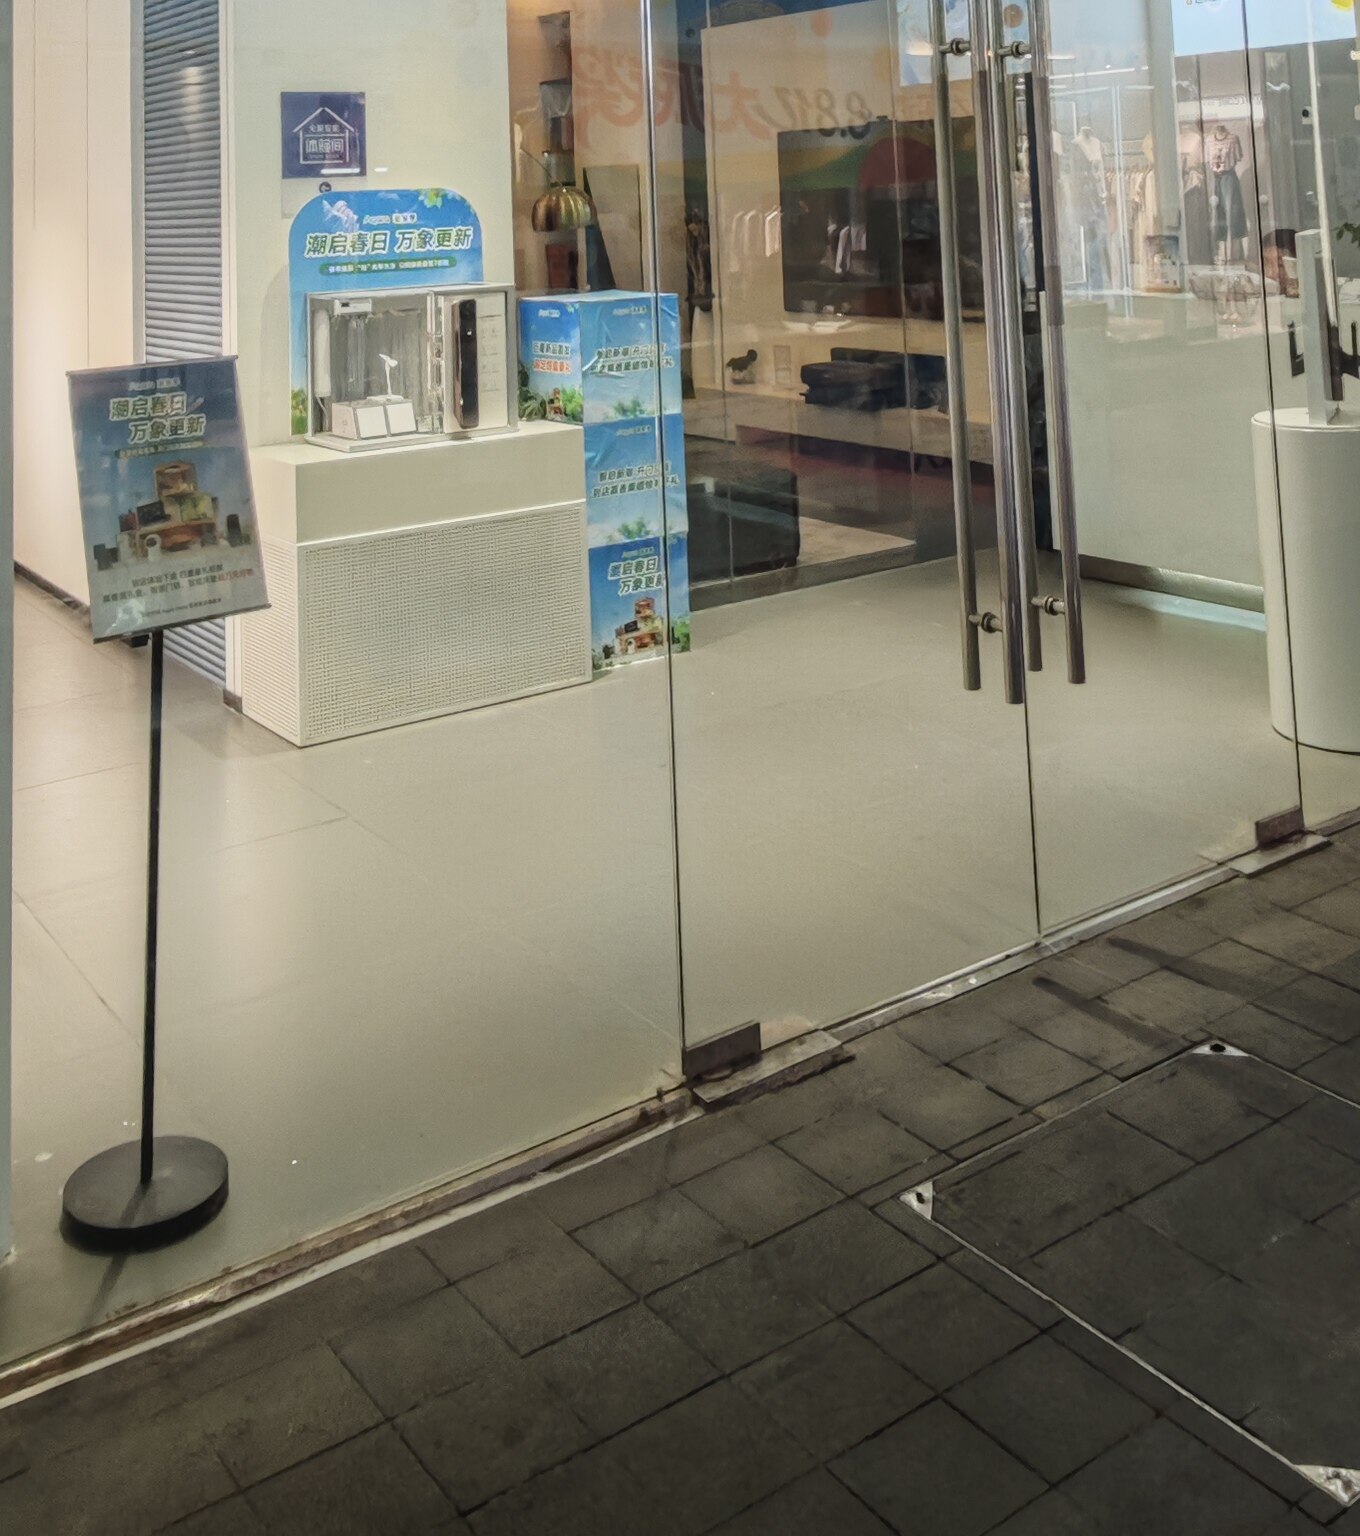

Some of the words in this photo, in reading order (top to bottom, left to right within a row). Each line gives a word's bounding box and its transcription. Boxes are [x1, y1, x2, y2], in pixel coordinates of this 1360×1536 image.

[304, 230, 390, 258] 潮启春日
[395, 225, 474, 254] 万象更新
[129, 414, 207, 445] 万象更新
